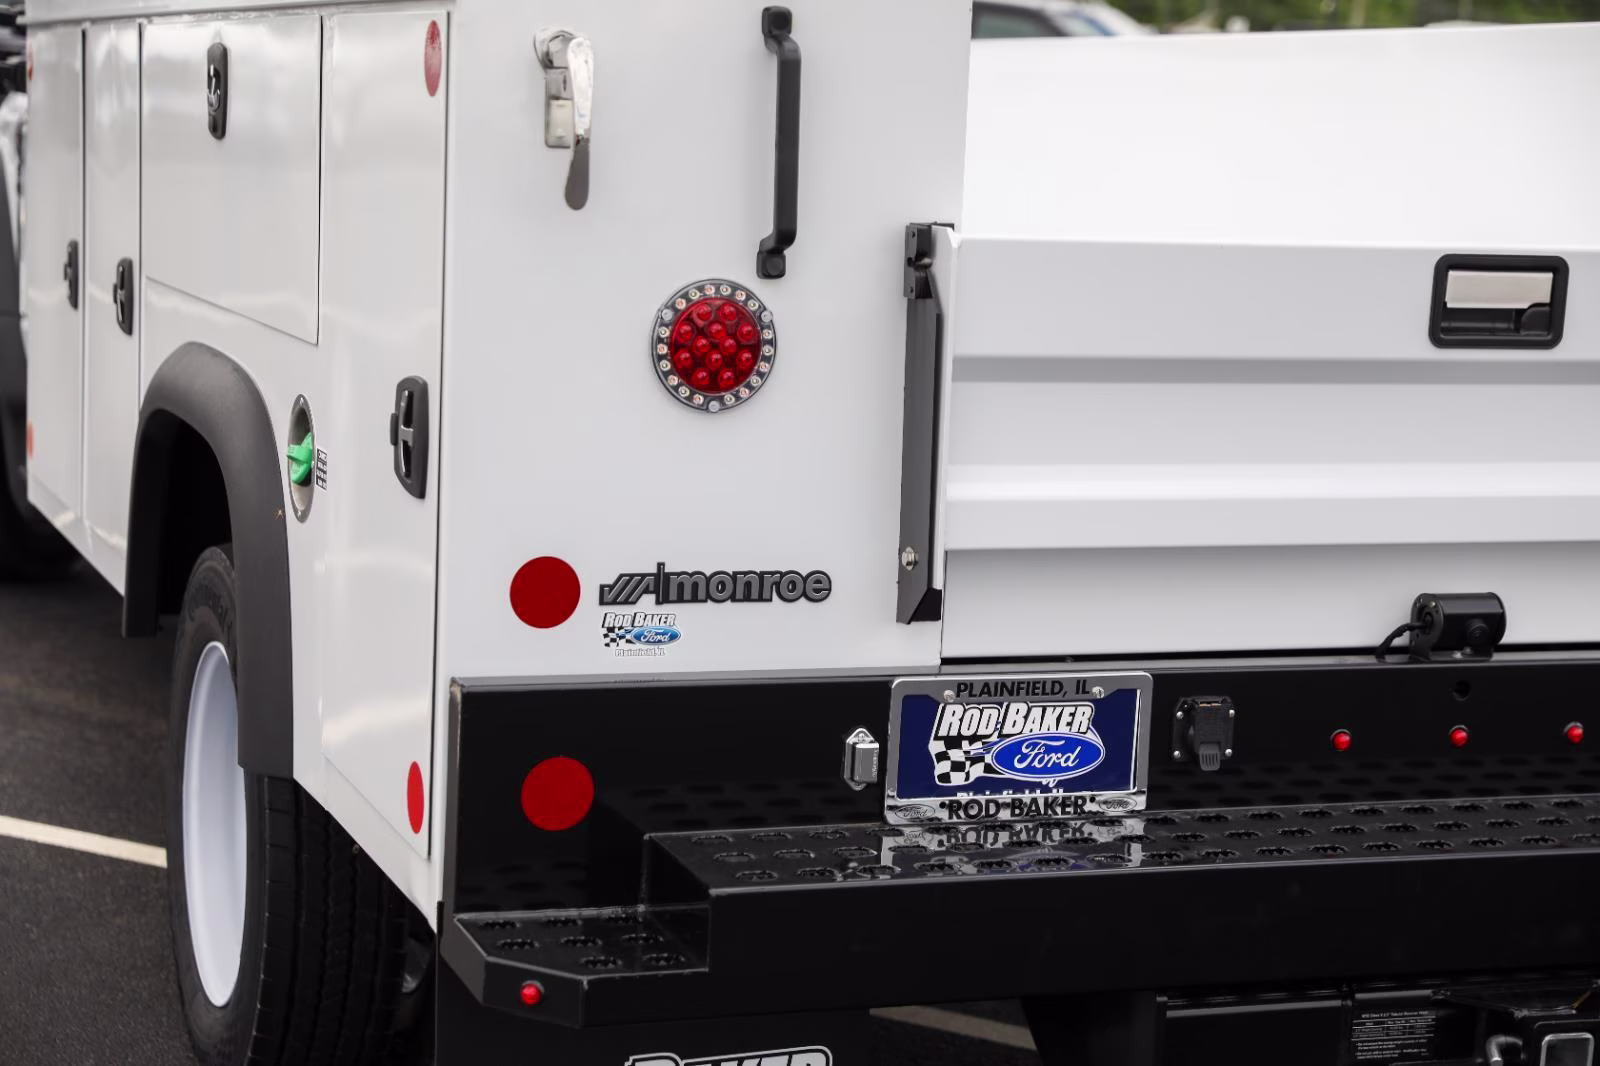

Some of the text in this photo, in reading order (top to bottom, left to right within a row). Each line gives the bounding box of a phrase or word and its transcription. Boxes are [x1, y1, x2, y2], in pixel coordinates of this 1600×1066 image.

[667, 570, 832, 603] monroe
[602, 611, 677, 628] ROD BAKER
[641, 629, 673, 642] Ford
[956, 679, 1090, 698] PLAINFIELD, IL
[937, 701, 1092, 737] ROD BAKER
[1014, 739, 1082, 769] Ford
[948, 796, 1088, 820] ROD BAKER
